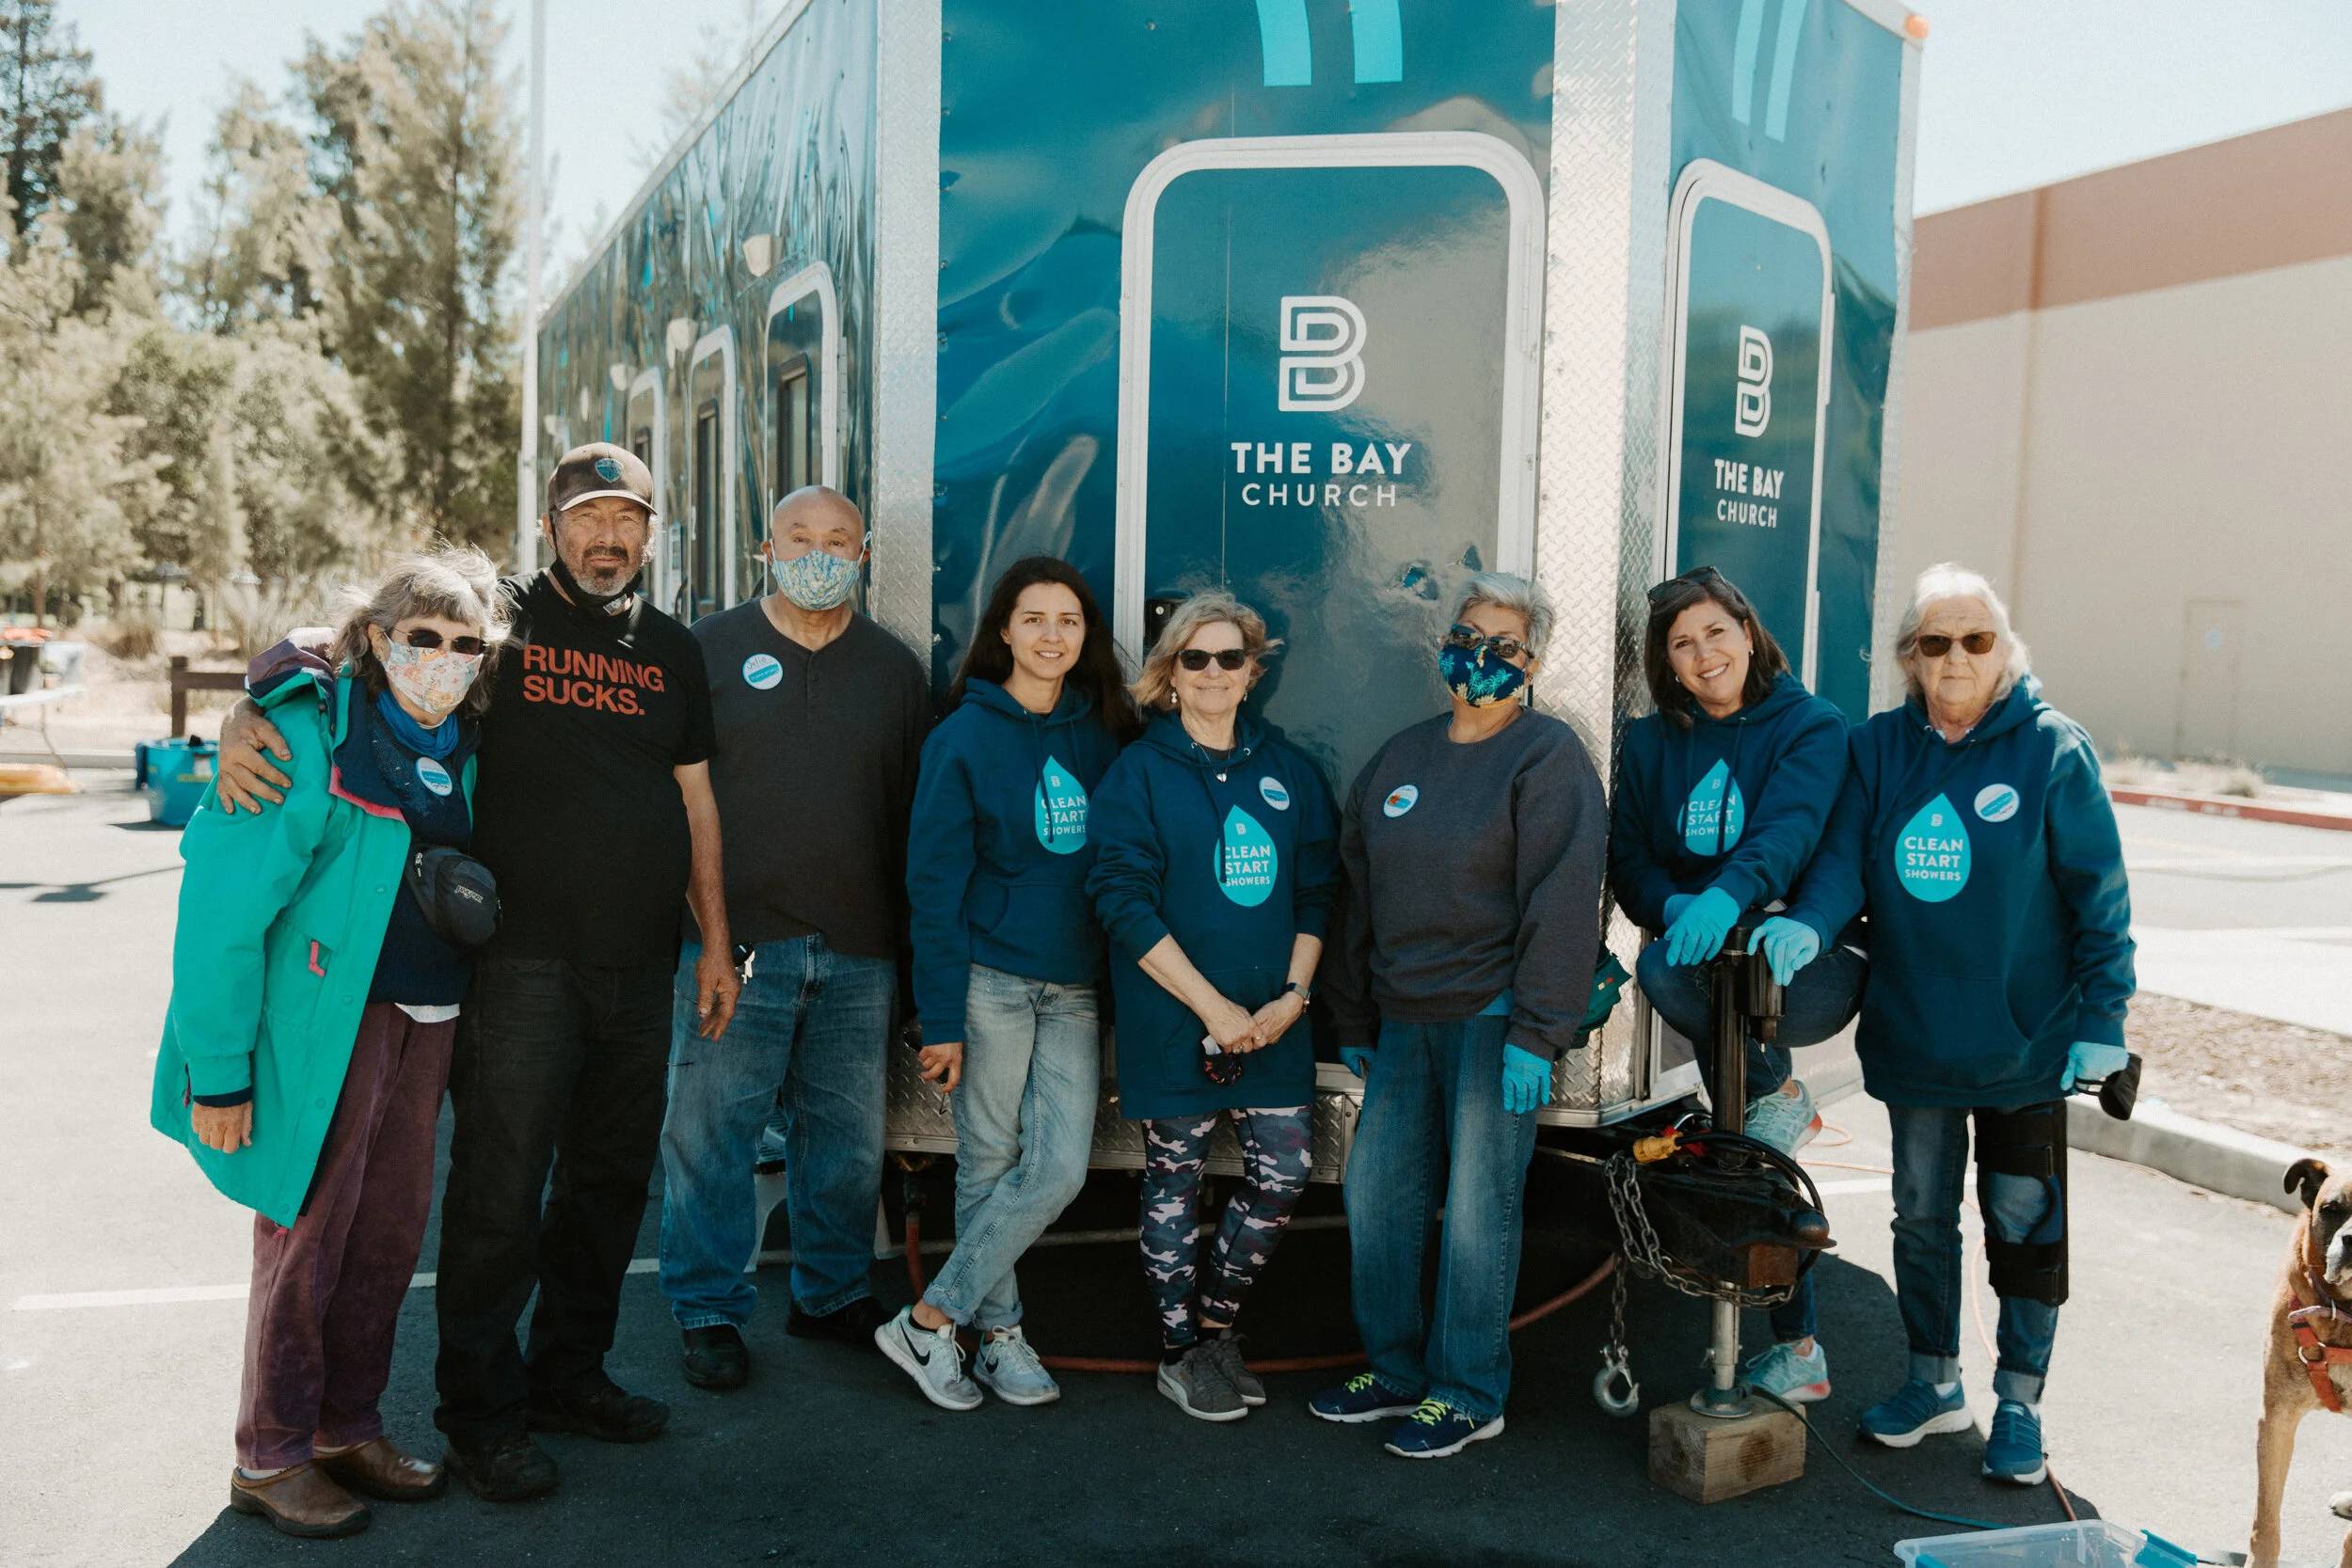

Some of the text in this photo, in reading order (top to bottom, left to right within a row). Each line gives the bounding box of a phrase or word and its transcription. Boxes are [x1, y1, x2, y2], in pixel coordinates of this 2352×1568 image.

[1231, 442, 1411, 474] THE BAY
[1714, 458, 1785, 499] THE BAY
[1242, 483, 1396, 507] CHURCH
[1717, 499, 1777, 529] CHURCH
[523, 644, 665, 693] RUNNING
[522, 674, 645, 715] SUCKS.
[1903, 836, 1963, 851] CLEAN
[1225, 860, 1269, 875] START
[1906, 852, 1961, 868] START
[1226, 876, 1271, 887] SHOWERS
[1904, 869, 1962, 880] SHOWERS
